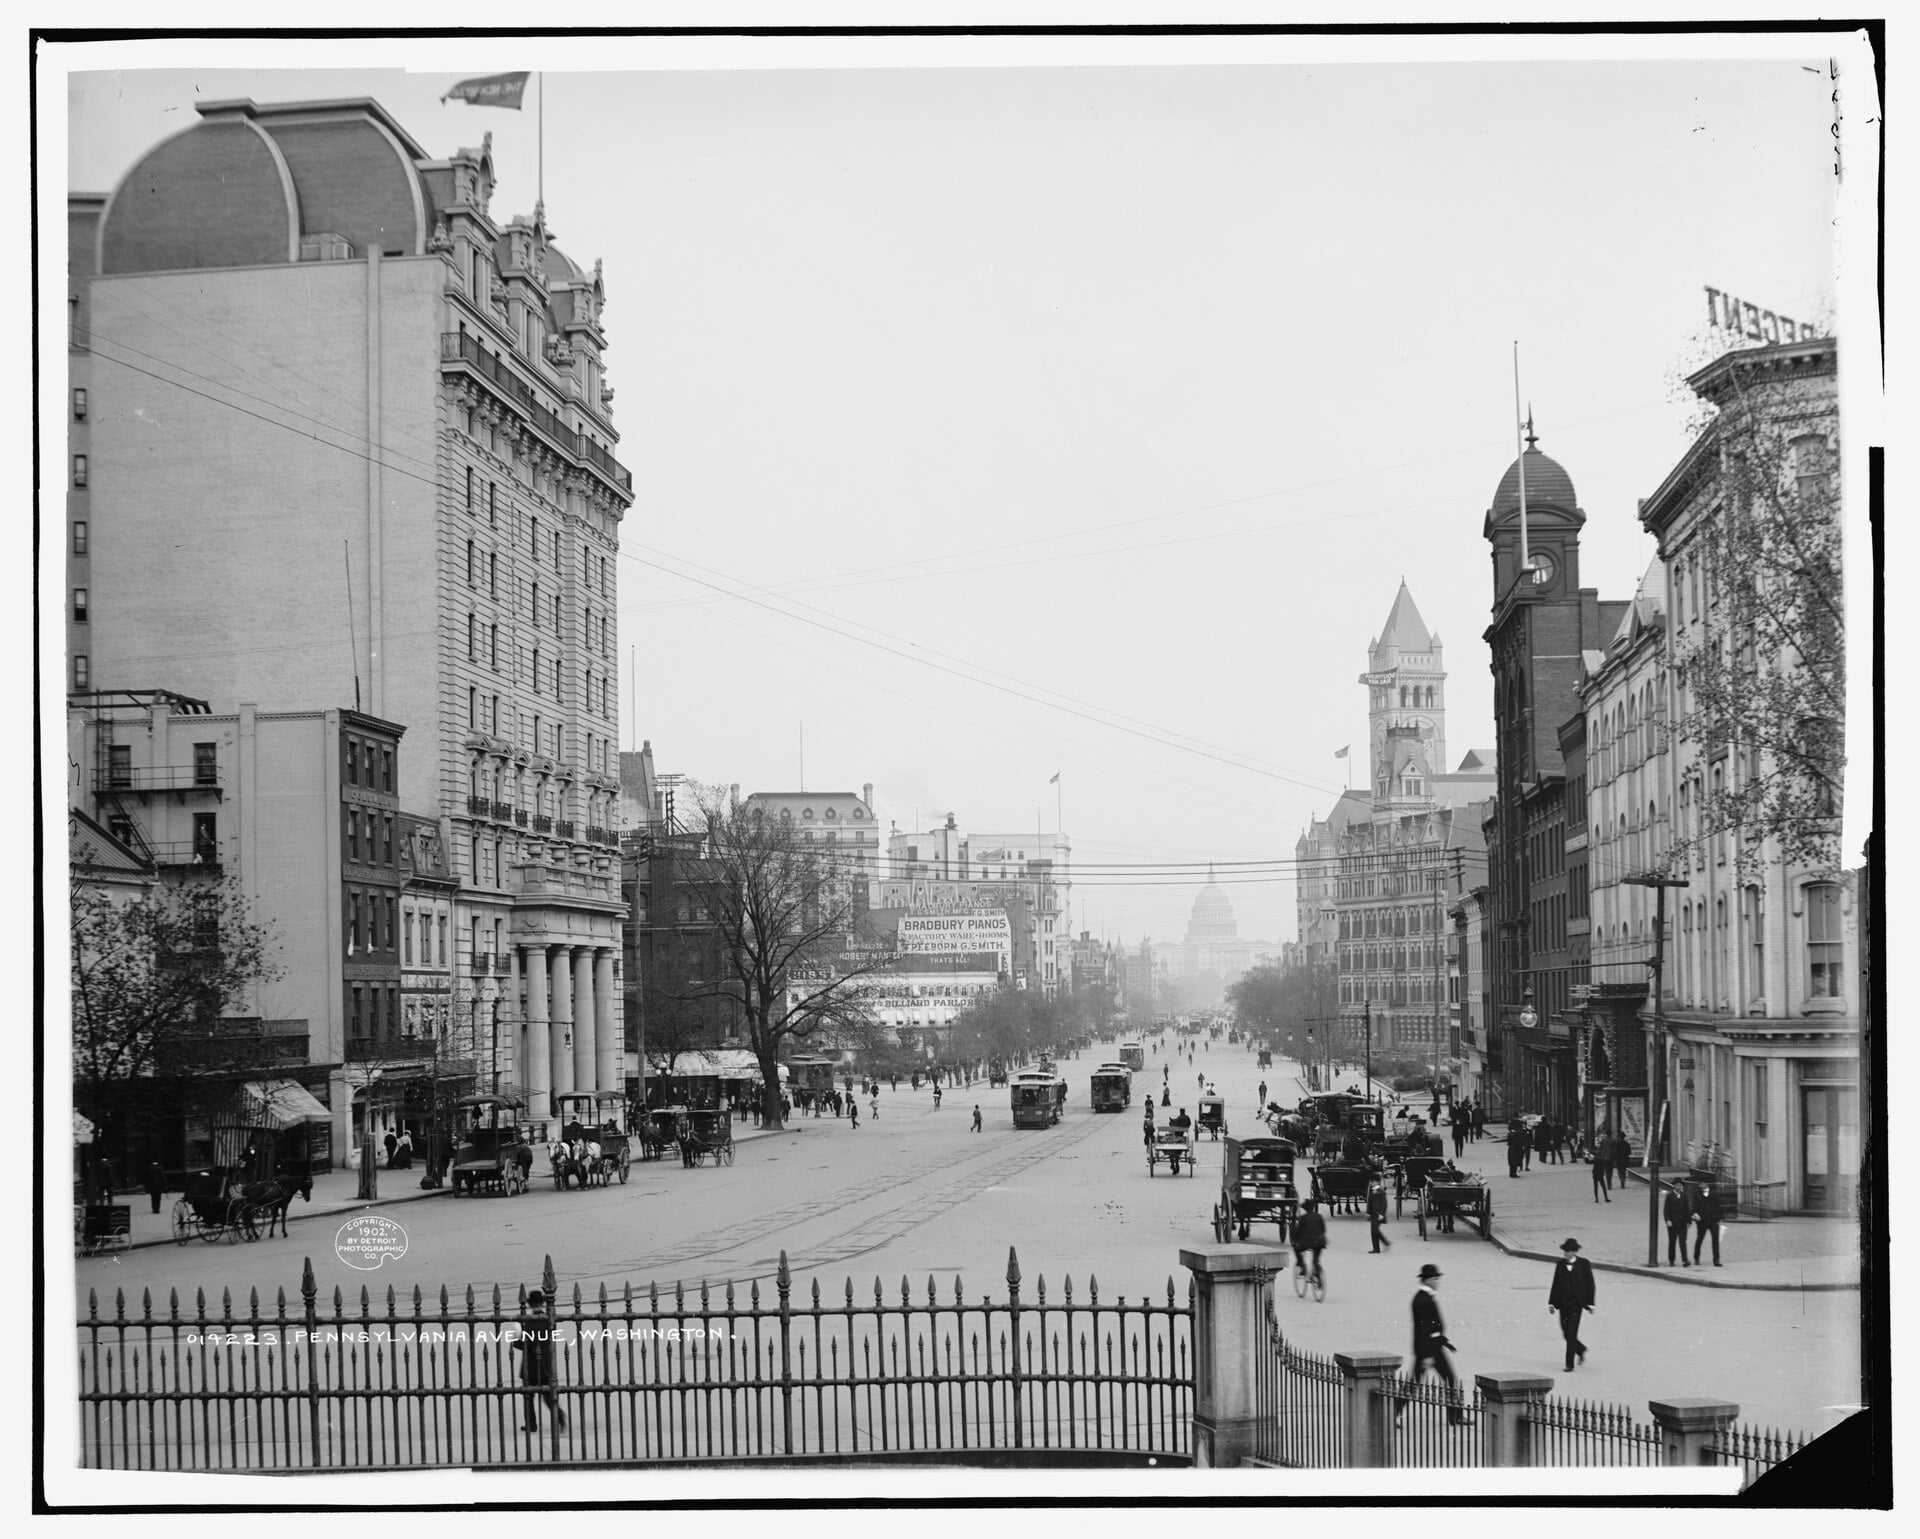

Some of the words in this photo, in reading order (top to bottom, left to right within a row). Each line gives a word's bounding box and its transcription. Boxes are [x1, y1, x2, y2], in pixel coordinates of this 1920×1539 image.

[904, 920, 964, 931] BRADBURY
[967, 918, 1007, 930] PIANOS
[908, 932, 947, 941] FACTORY
[885, 999, 930, 1008] BILLIARD
